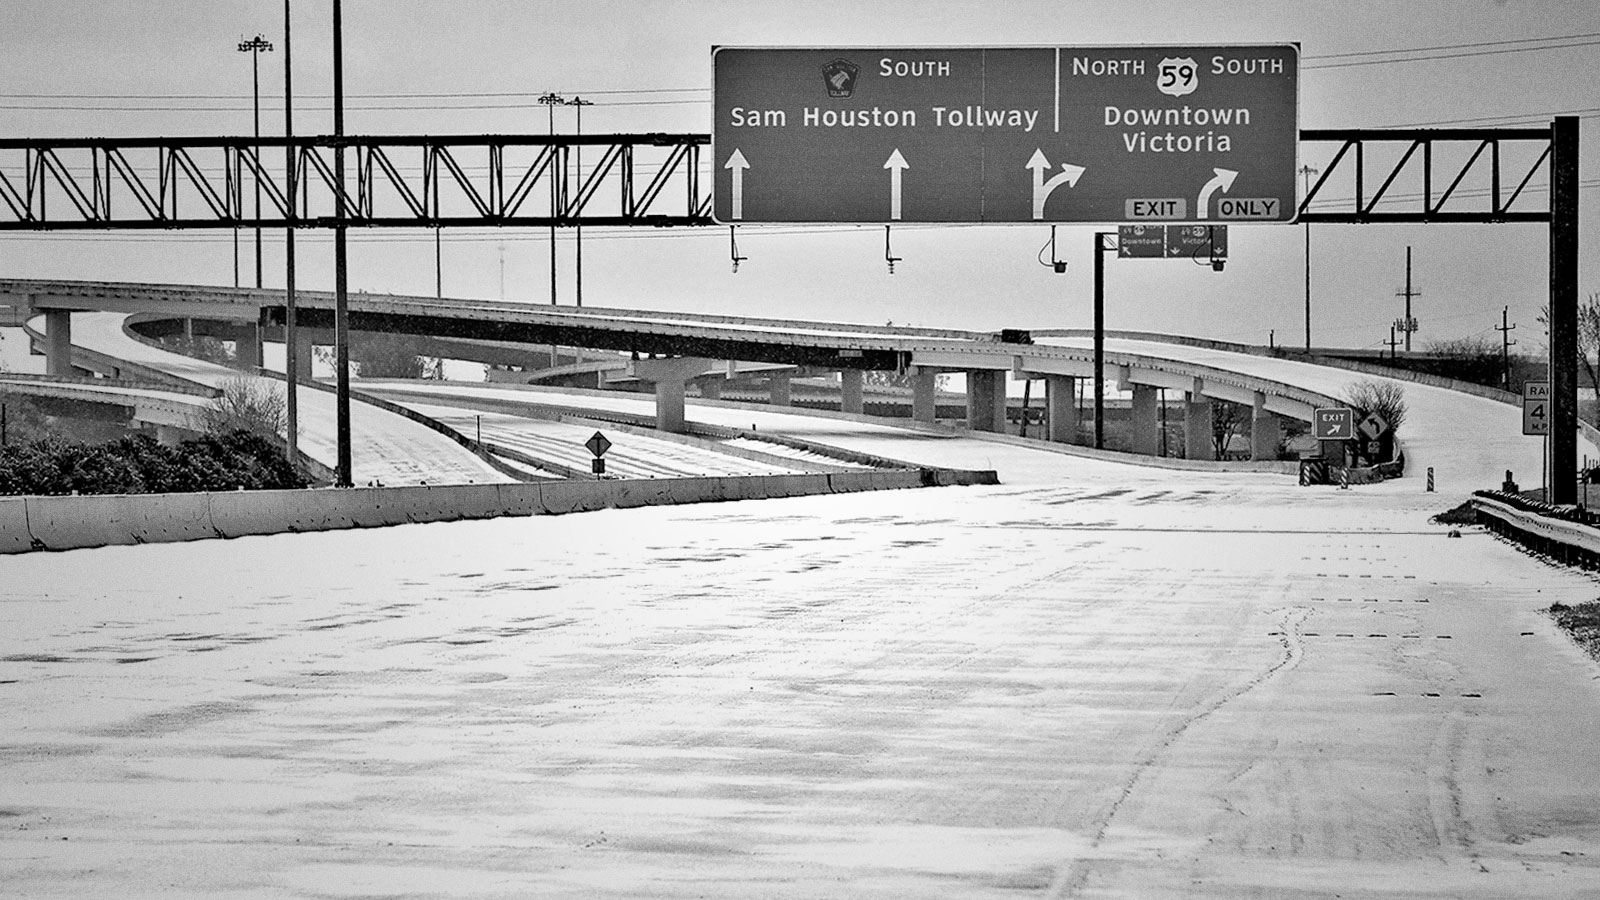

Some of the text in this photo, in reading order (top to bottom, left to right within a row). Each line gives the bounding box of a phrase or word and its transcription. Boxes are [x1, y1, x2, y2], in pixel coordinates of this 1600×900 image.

[879, 57, 950, 77] SOUTH
[1072, 55, 1283, 88] NORTH 59 SOUTH
[730, 105, 1039, 132] Sam Houston Tollway
[1104, 105, 1250, 126] Downtown
[1122, 130, 1231, 153] Victoria
[1133, 201, 1178, 217] EXIT
[1220, 201, 1275, 217] ONLY
[1322, 413, 1345, 422] EXIT
